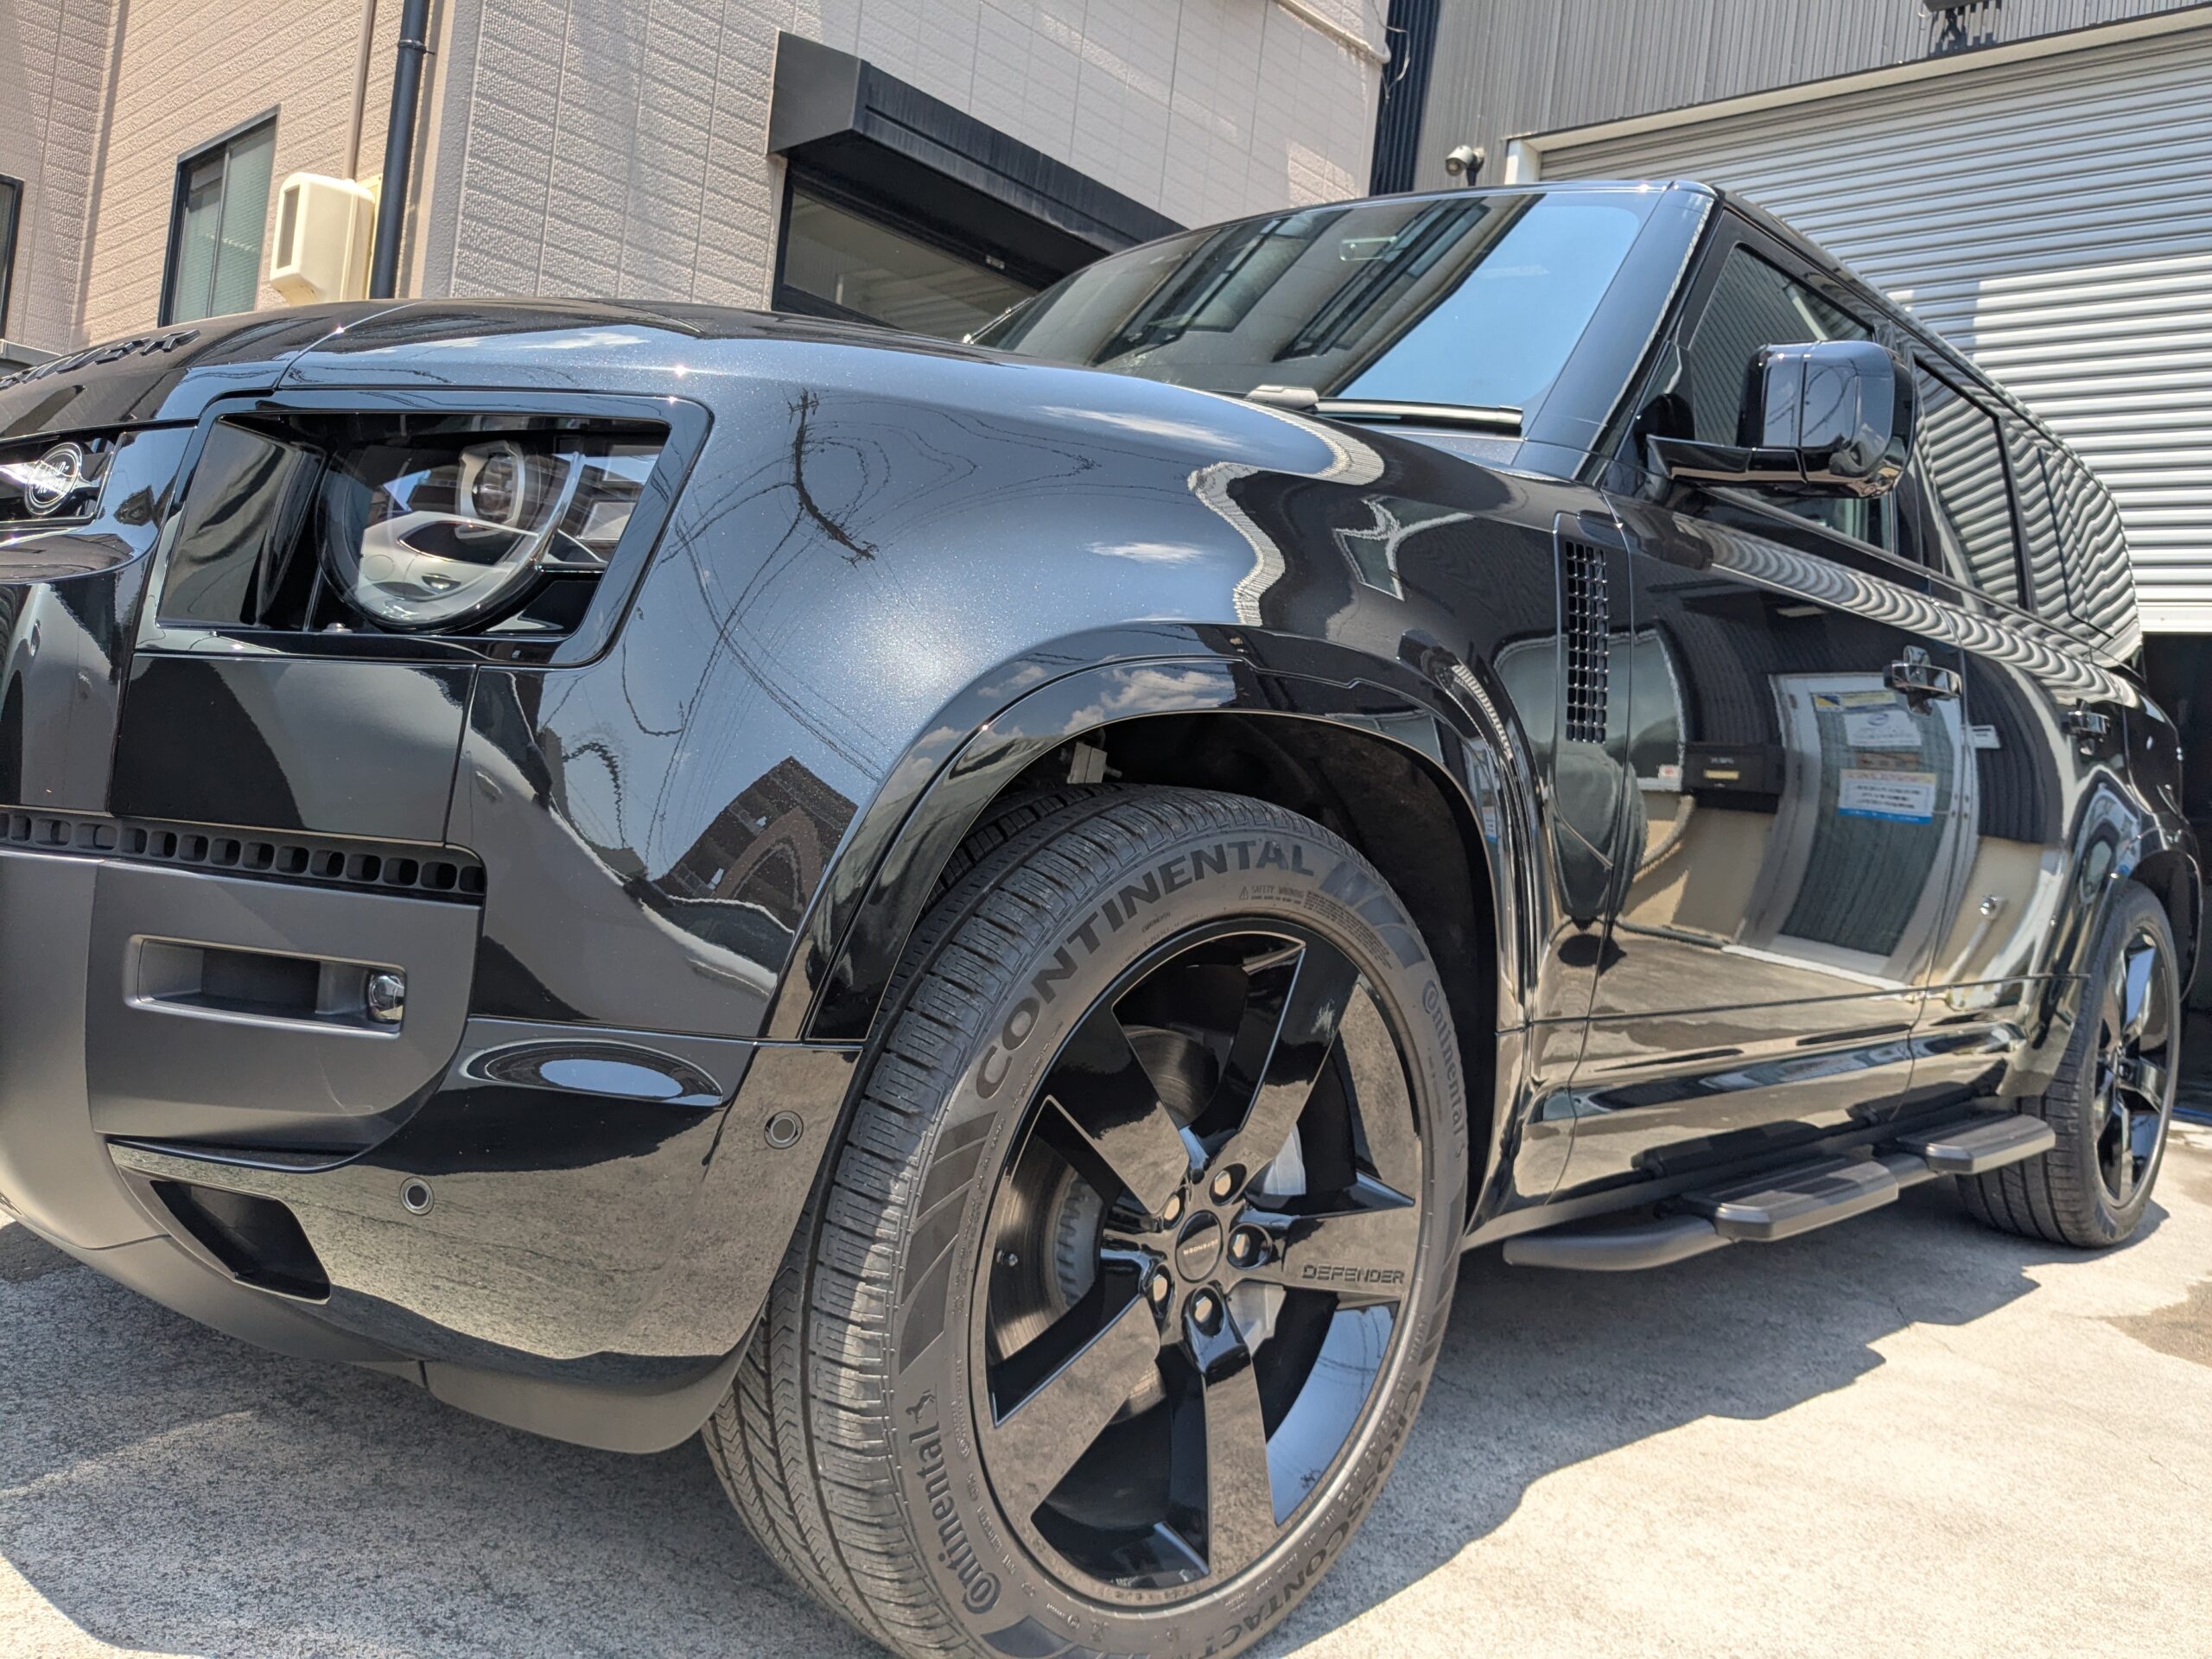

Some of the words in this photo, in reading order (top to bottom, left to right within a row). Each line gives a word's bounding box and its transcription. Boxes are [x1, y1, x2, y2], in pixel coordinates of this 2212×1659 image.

[976, 839, 1315, 1099] CONTINENTAL
[1422, 980, 1465, 1135] Continental
[1301, 1263, 1404, 1284] DEFENDER
[909, 1421, 1001, 1614] Continental
